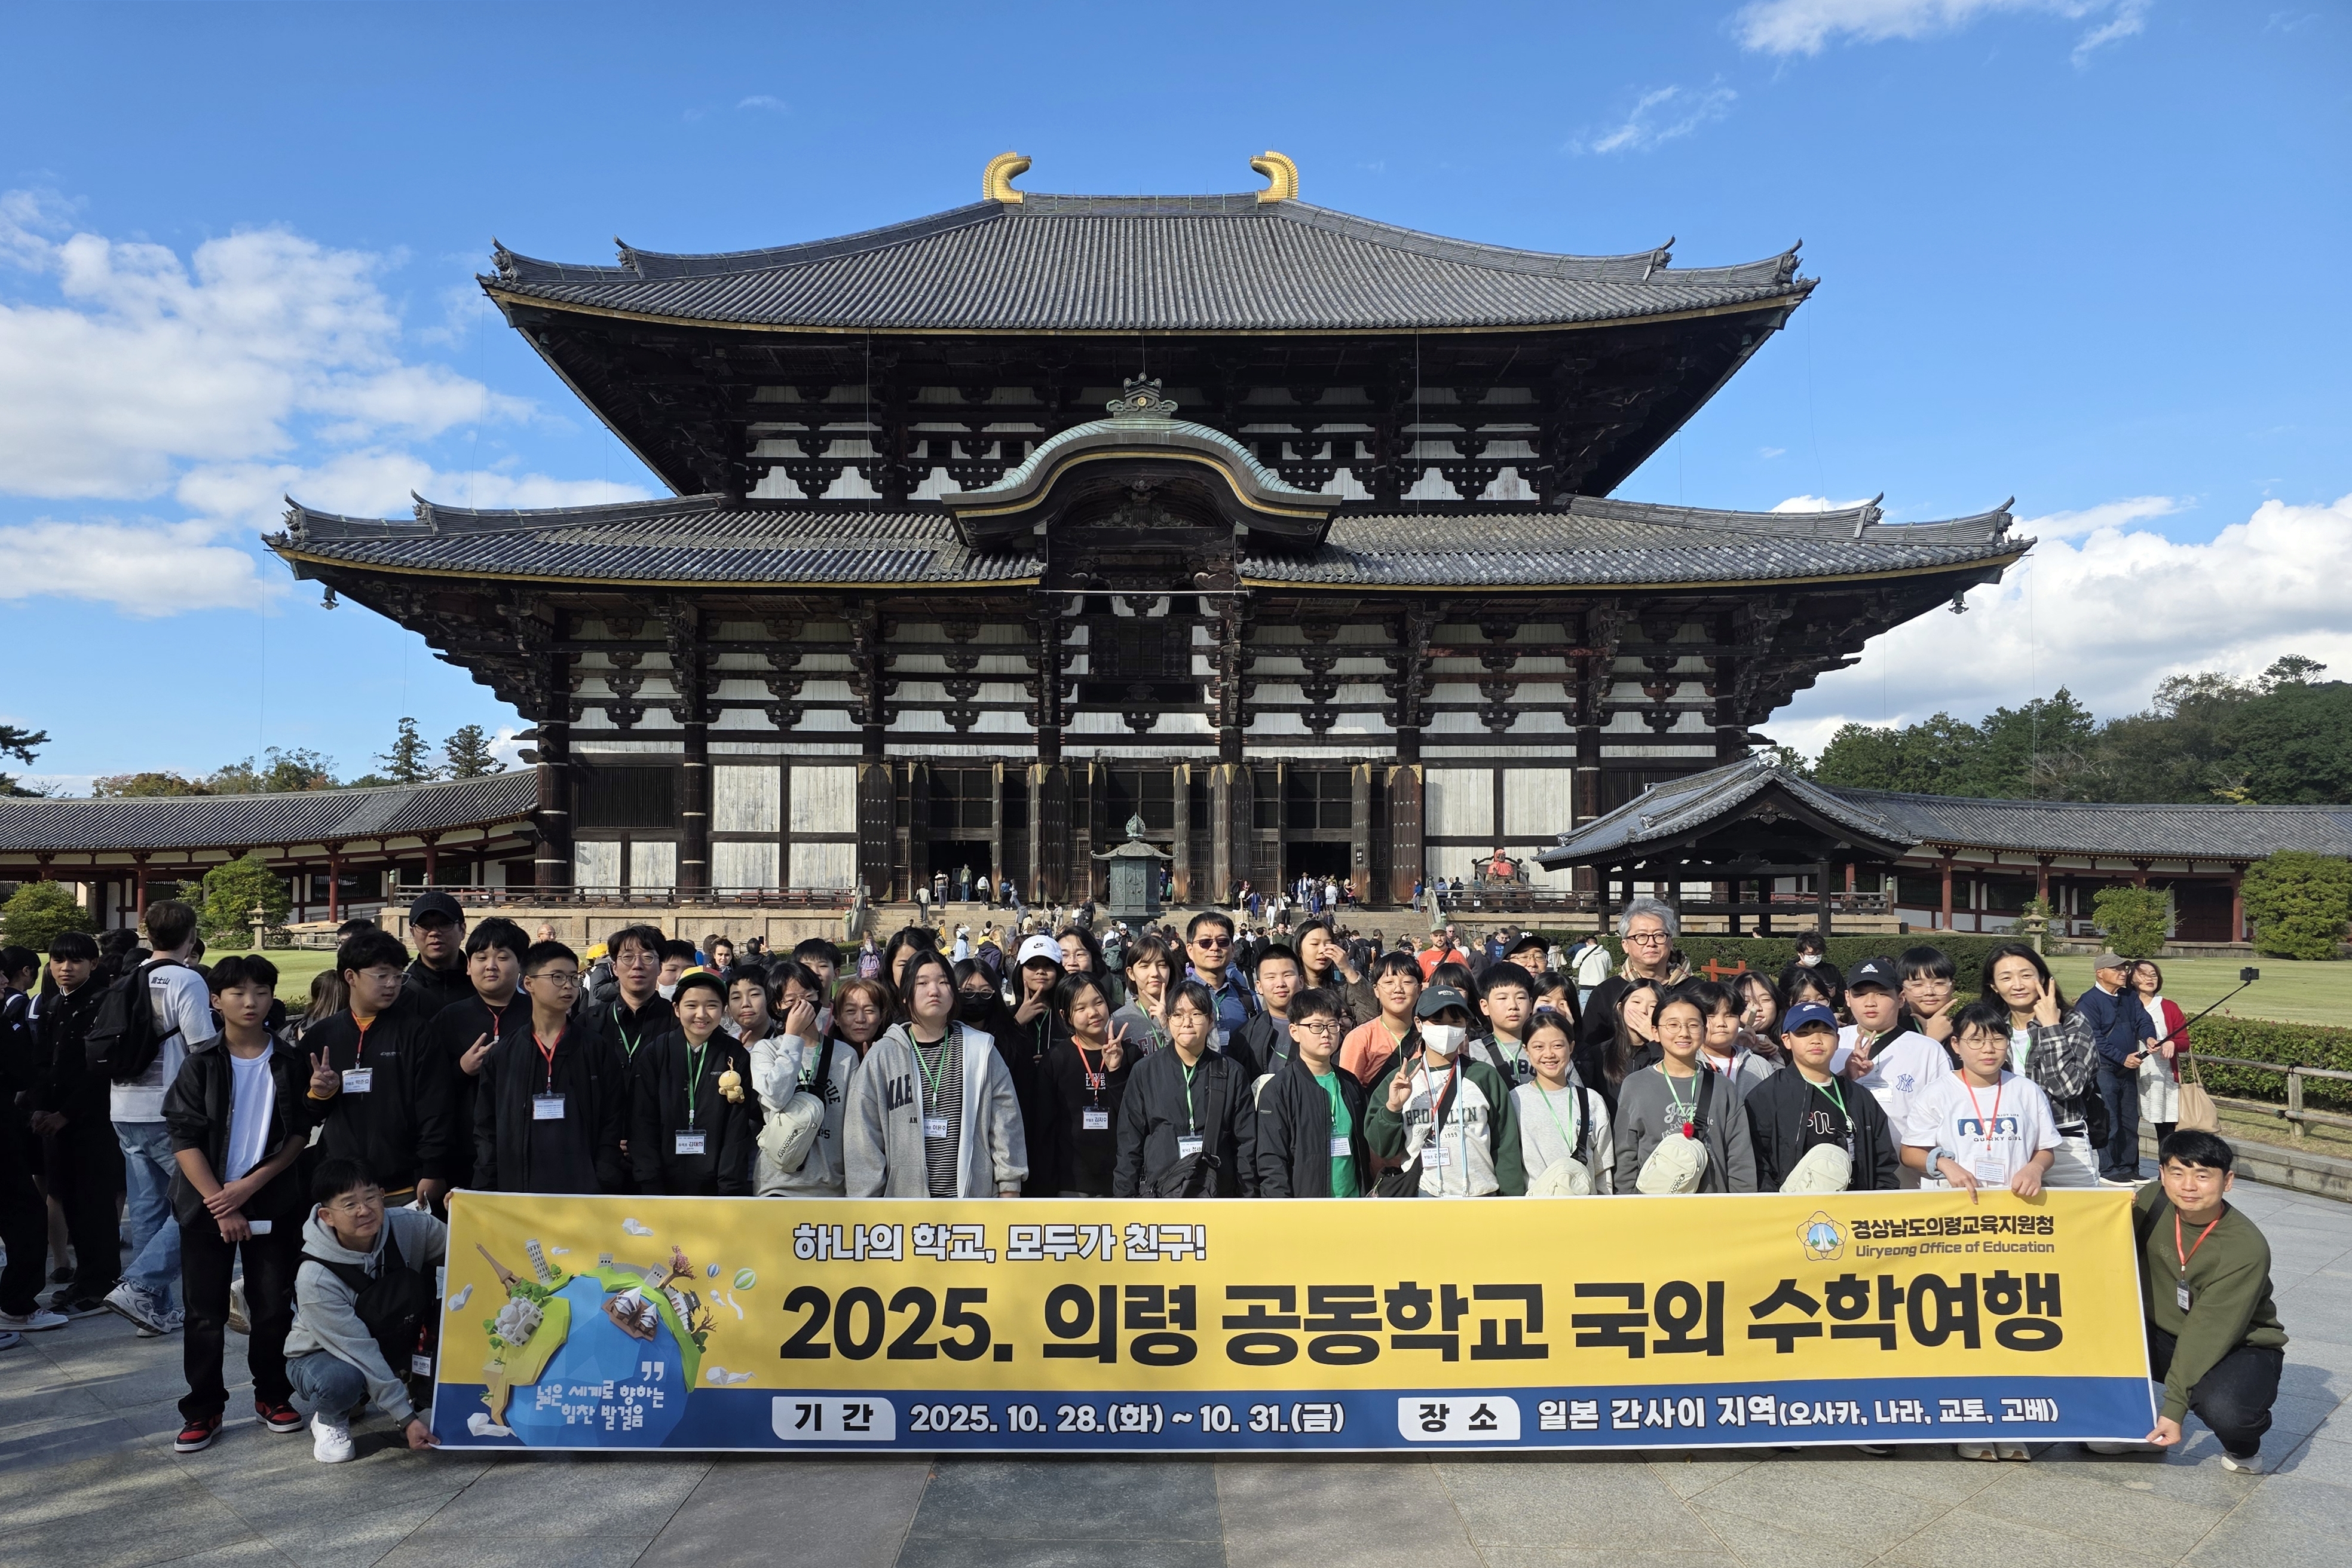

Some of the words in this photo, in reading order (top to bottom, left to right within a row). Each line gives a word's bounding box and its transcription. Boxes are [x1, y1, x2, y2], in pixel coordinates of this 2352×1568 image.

[151, 976, 171, 985] 富士山
[1851, 1215, 2054, 1239] 경상남도의령교육지원청
[793, 1224, 903, 1261] 하나의
[912, 1223, 996, 1263] 학교,
[1006, 1224, 1116, 1261] 모두가
[1125, 1223, 1206, 1261] 친구!
[1856, 1244, 1917, 1258] Uiryeong
[1920, 1242, 1962, 1255] Office
[1965, 1241, 1980, 1252] of
[1983, 1241, 2054, 1253] Education
[780, 1285, 1013, 1362] 2025.
[1043, 1284, 1198, 1366] 의령
[1222, 1281, 1549, 1366] 공동학교
[1572, 1280, 1725, 1359] 국외
[1748, 1269, 2063, 1353] 수학여행
[535, 1384, 562, 1410] 넓은
[568, 1380, 614, 1399] 세계로
[620, 1385, 664, 1408] 향하는
[561, 1404, 595, 1425] 힘찬
[601, 1404, 643, 1431] 발걸음
[909, 1403, 999, 1432] 2025.
[1007, 1404, 1048, 1433] 10.
[1056, 1403, 1164, 1434] 28.(화)
[1199, 1402, 1240, 1433] 10.
[1248, 1402, 1345, 1434] 31.(금)
[1537, 1399, 1600, 1432] 일본
[1610, 1397, 1707, 1431] 간사이
[1873, 1399, 1933, 1425] 나라,
[1938, 1398, 1995, 1425] 교토,
[1999, 1397, 2059, 1423] 고베)
